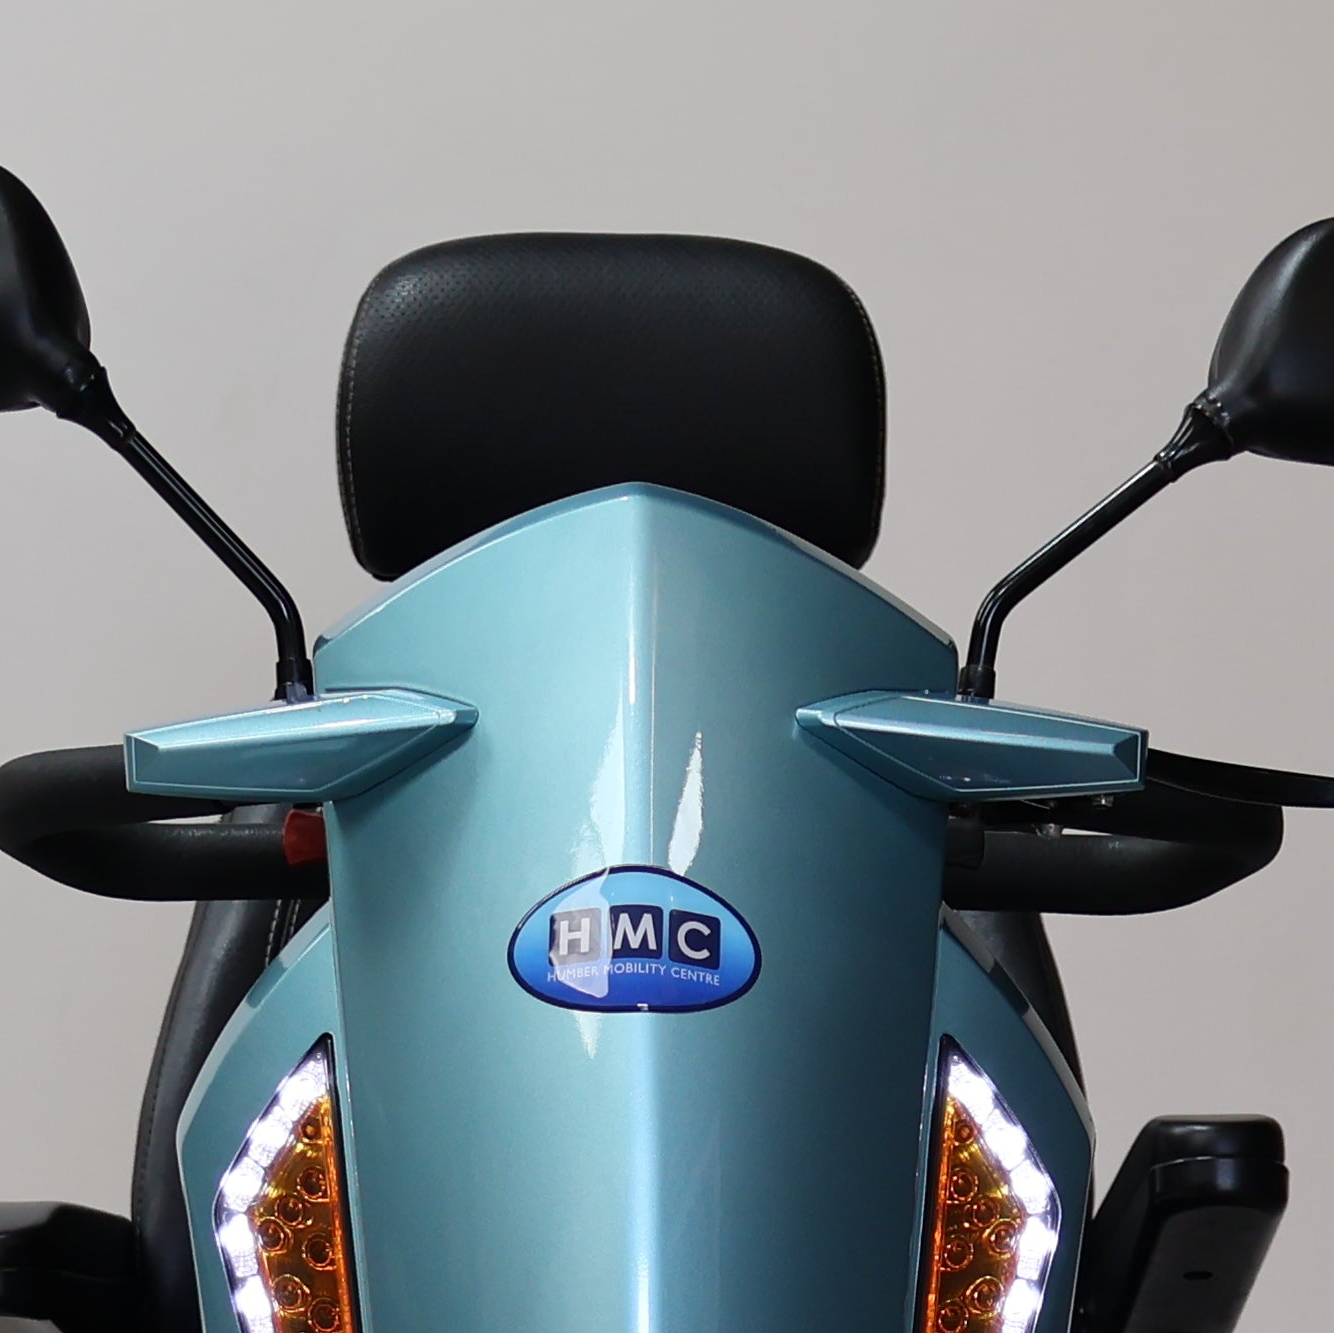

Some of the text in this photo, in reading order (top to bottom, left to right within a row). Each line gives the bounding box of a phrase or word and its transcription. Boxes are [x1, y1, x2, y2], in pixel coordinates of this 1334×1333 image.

[558, 912, 712, 961] HMC
[547, 962, 721, 987] HUMBER MOBILITY CENTRE
